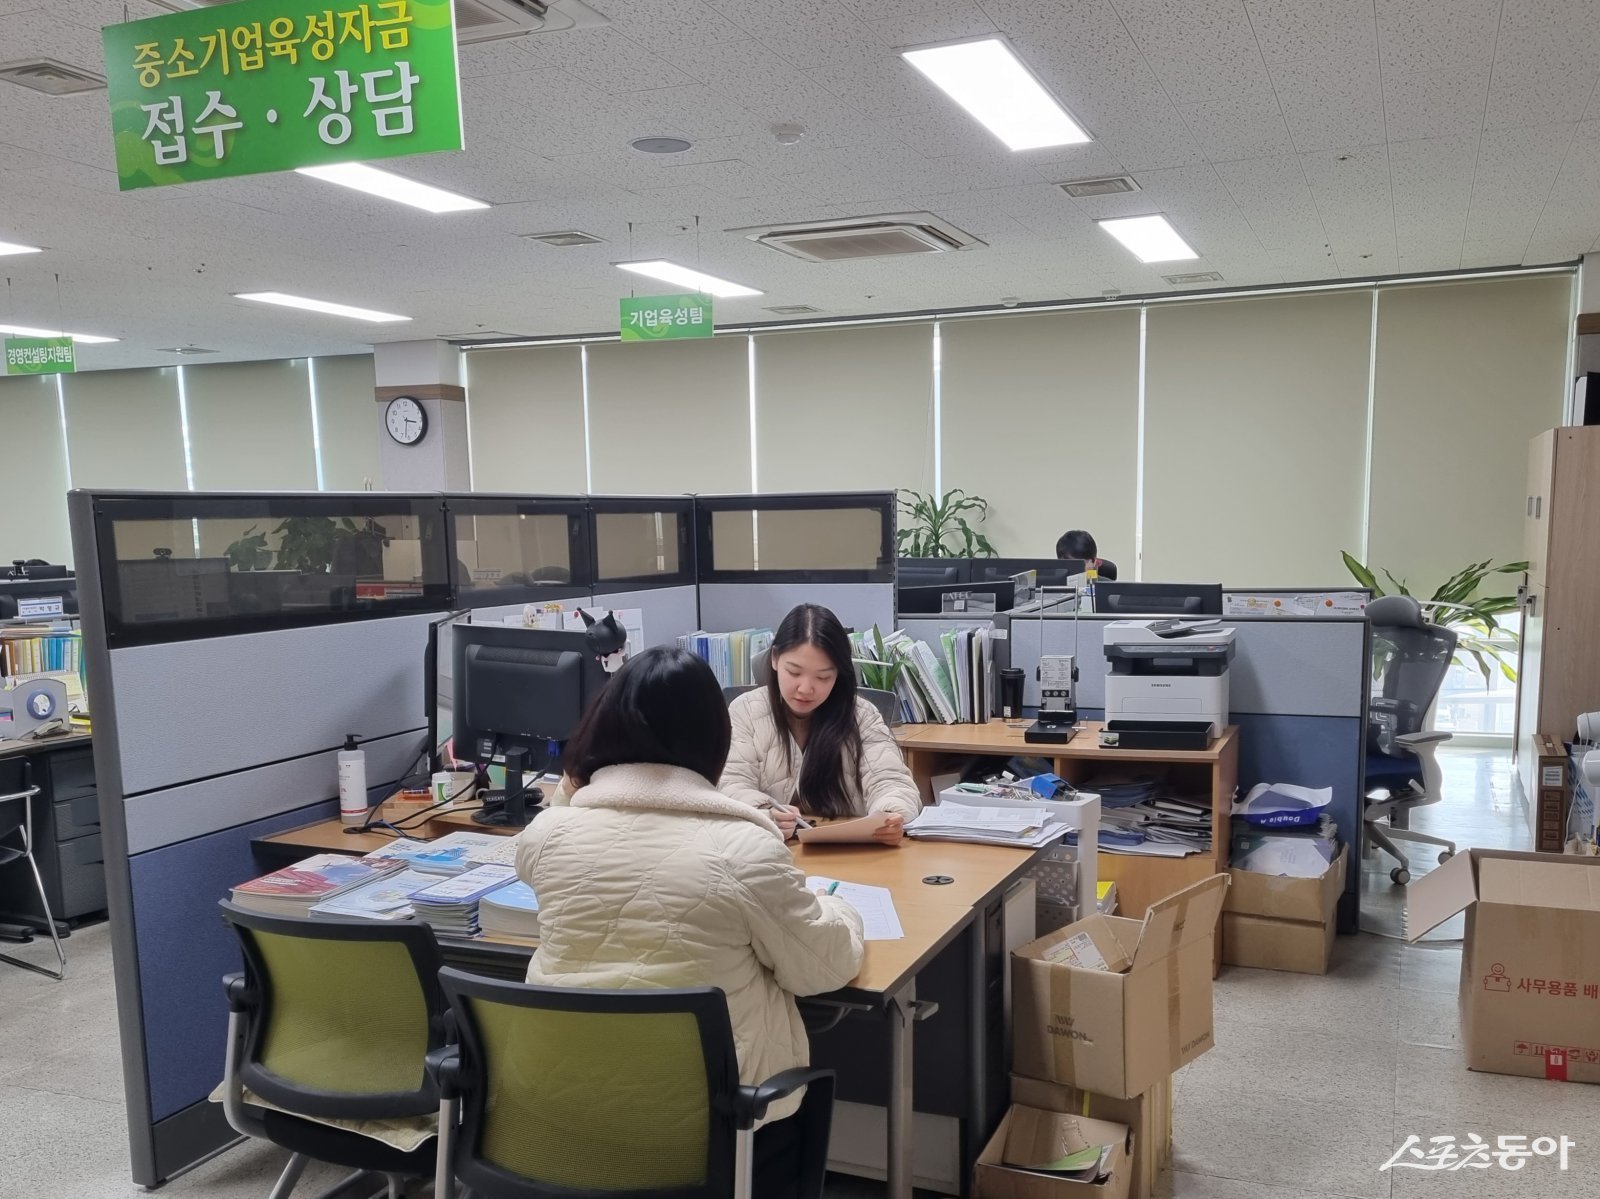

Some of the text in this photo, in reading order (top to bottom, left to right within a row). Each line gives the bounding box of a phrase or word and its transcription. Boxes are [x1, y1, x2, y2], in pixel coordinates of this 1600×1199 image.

[132, 1, 413, 88] 중소기업육성자금
[140, 91, 244, 166] 접수
[303, 61, 420, 146] 상담
[630, 307, 703, 327] 기업육성팀
[8, 345, 72, 365] 경영컨설팅지원팀
[1269, 815, 1301, 823] Double
[1517, 978, 1600, 1000] 사무용품 배
